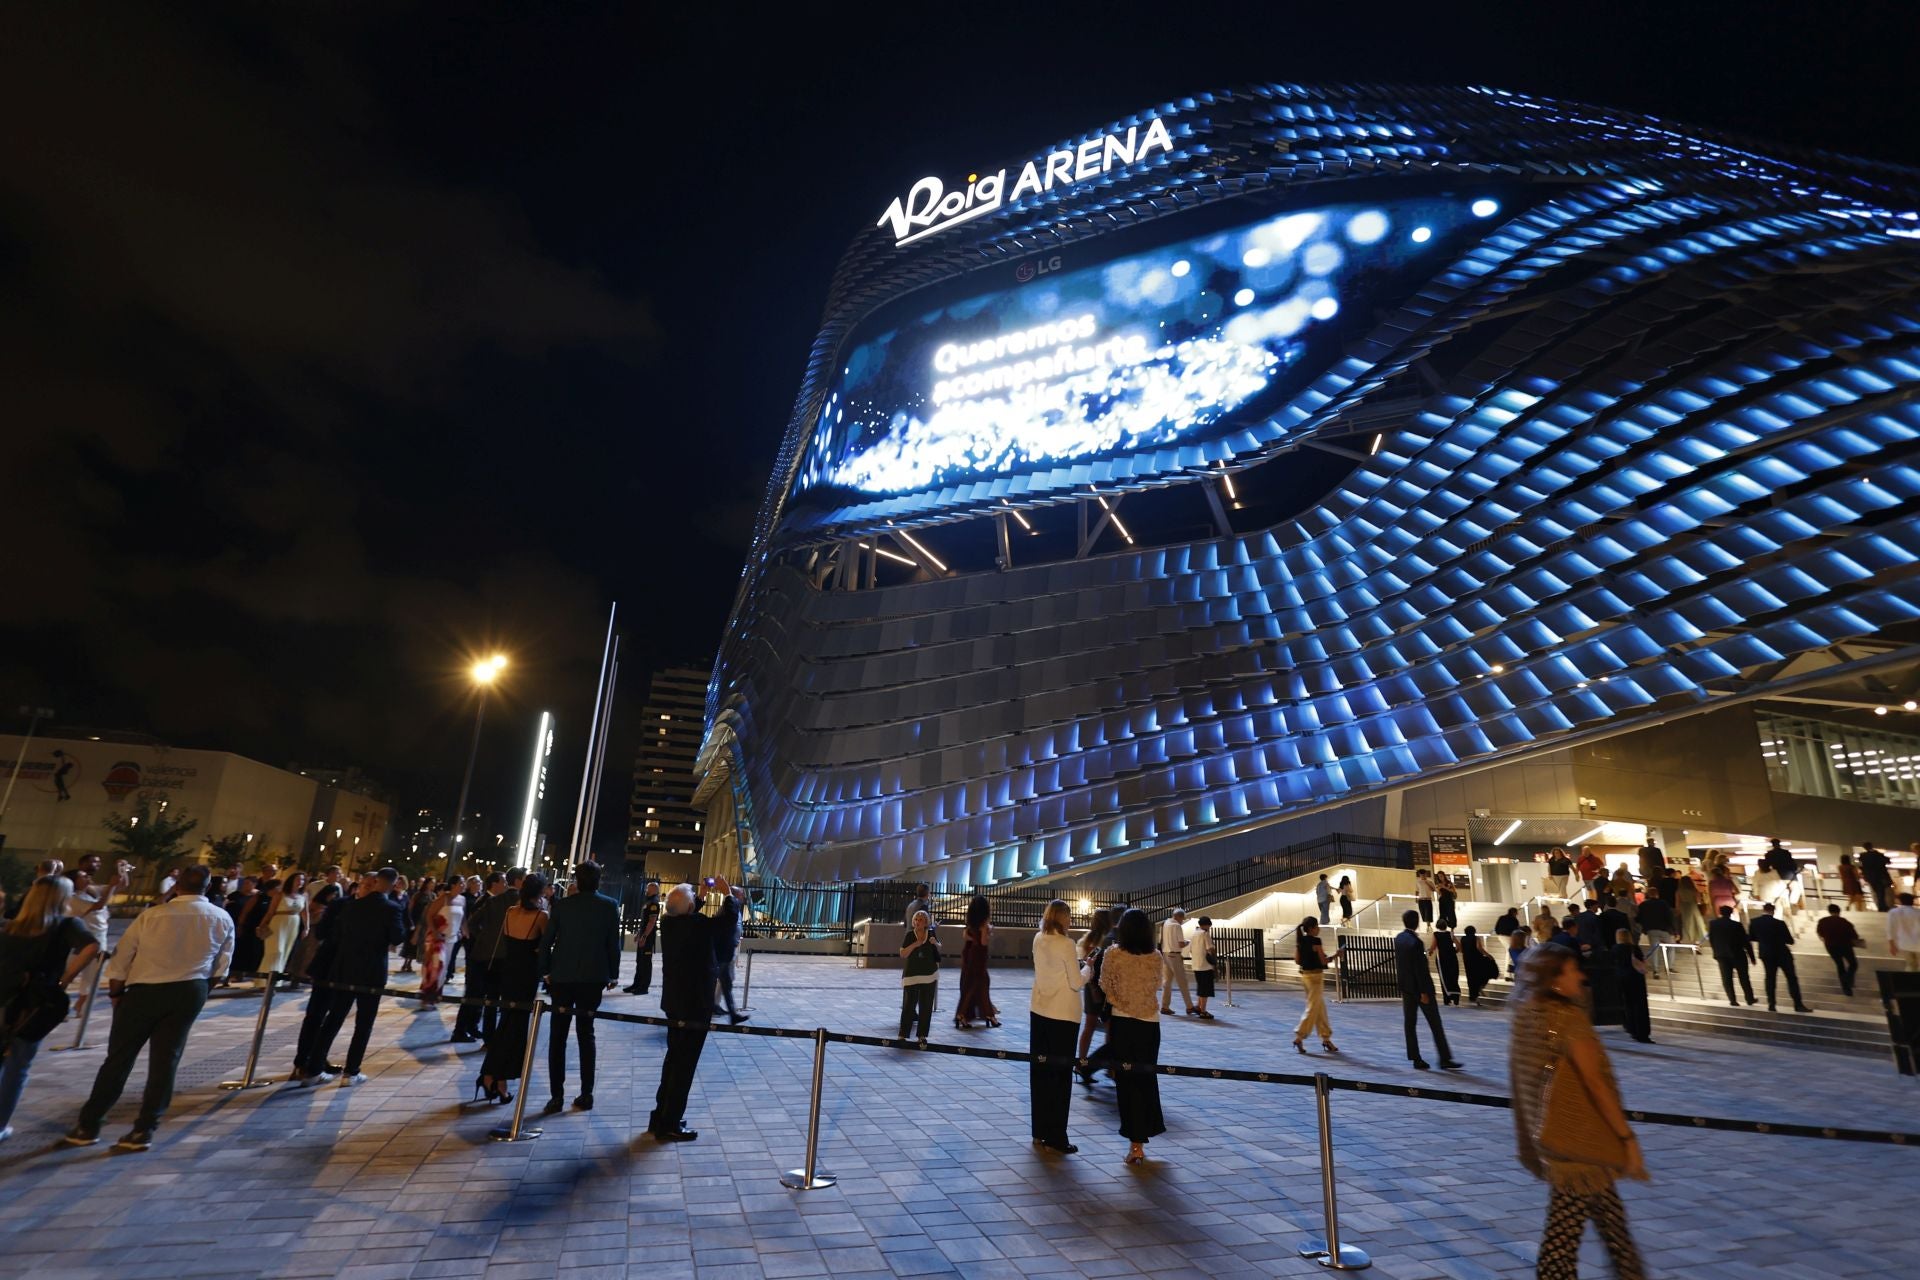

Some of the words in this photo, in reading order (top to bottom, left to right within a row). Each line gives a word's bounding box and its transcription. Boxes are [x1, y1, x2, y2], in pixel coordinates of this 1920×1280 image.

[877, 169, 1006, 246] Roig
[1009, 117, 1174, 202] ARENA
[1037, 255, 1063, 275] LG
[934, 313, 1096, 373] Queremos
